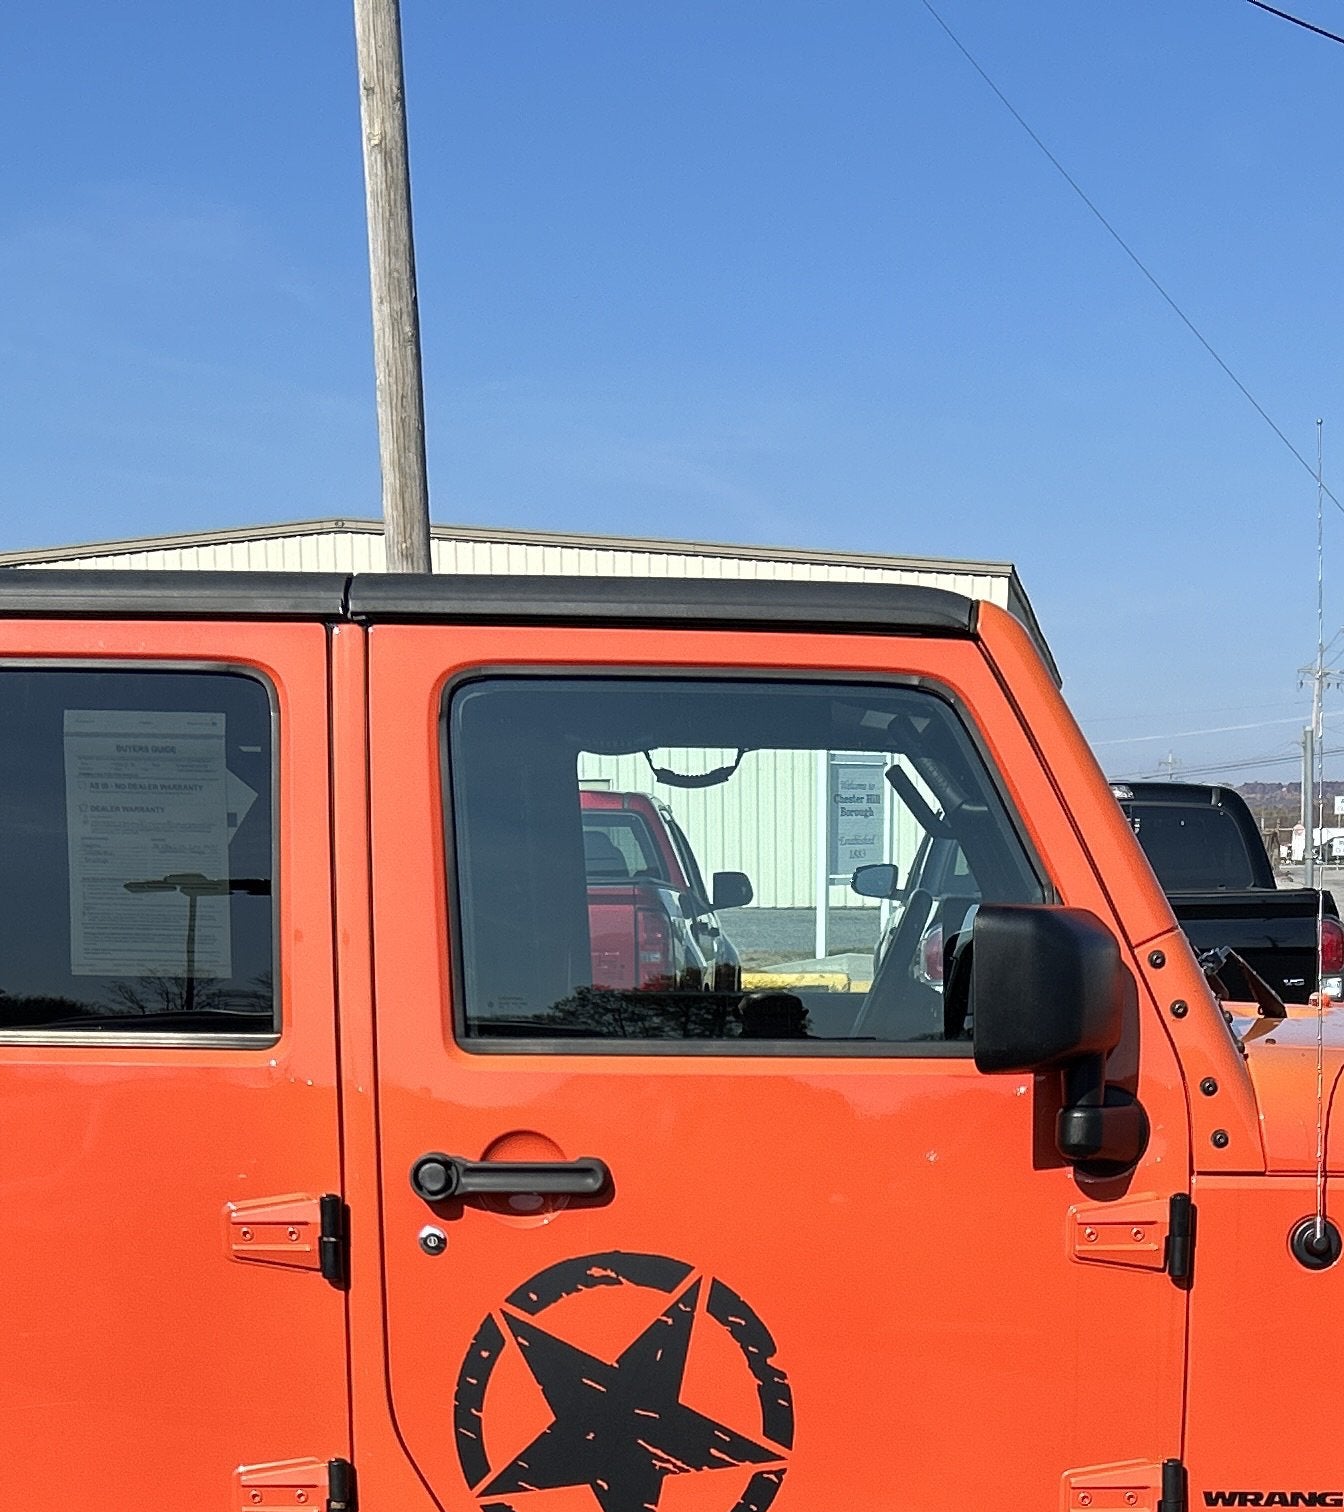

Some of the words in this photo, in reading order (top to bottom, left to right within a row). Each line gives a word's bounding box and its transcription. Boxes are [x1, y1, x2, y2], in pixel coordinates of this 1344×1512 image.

[160, 784, 203, 792] WARRANTY
[834, 794, 865, 804] Chester
[865, 794, 881, 804] Hill
[90, 805, 121, 813] DEALER
[122, 805, 165, 814] WARRANTY
[840, 807, 874, 818] Borough
